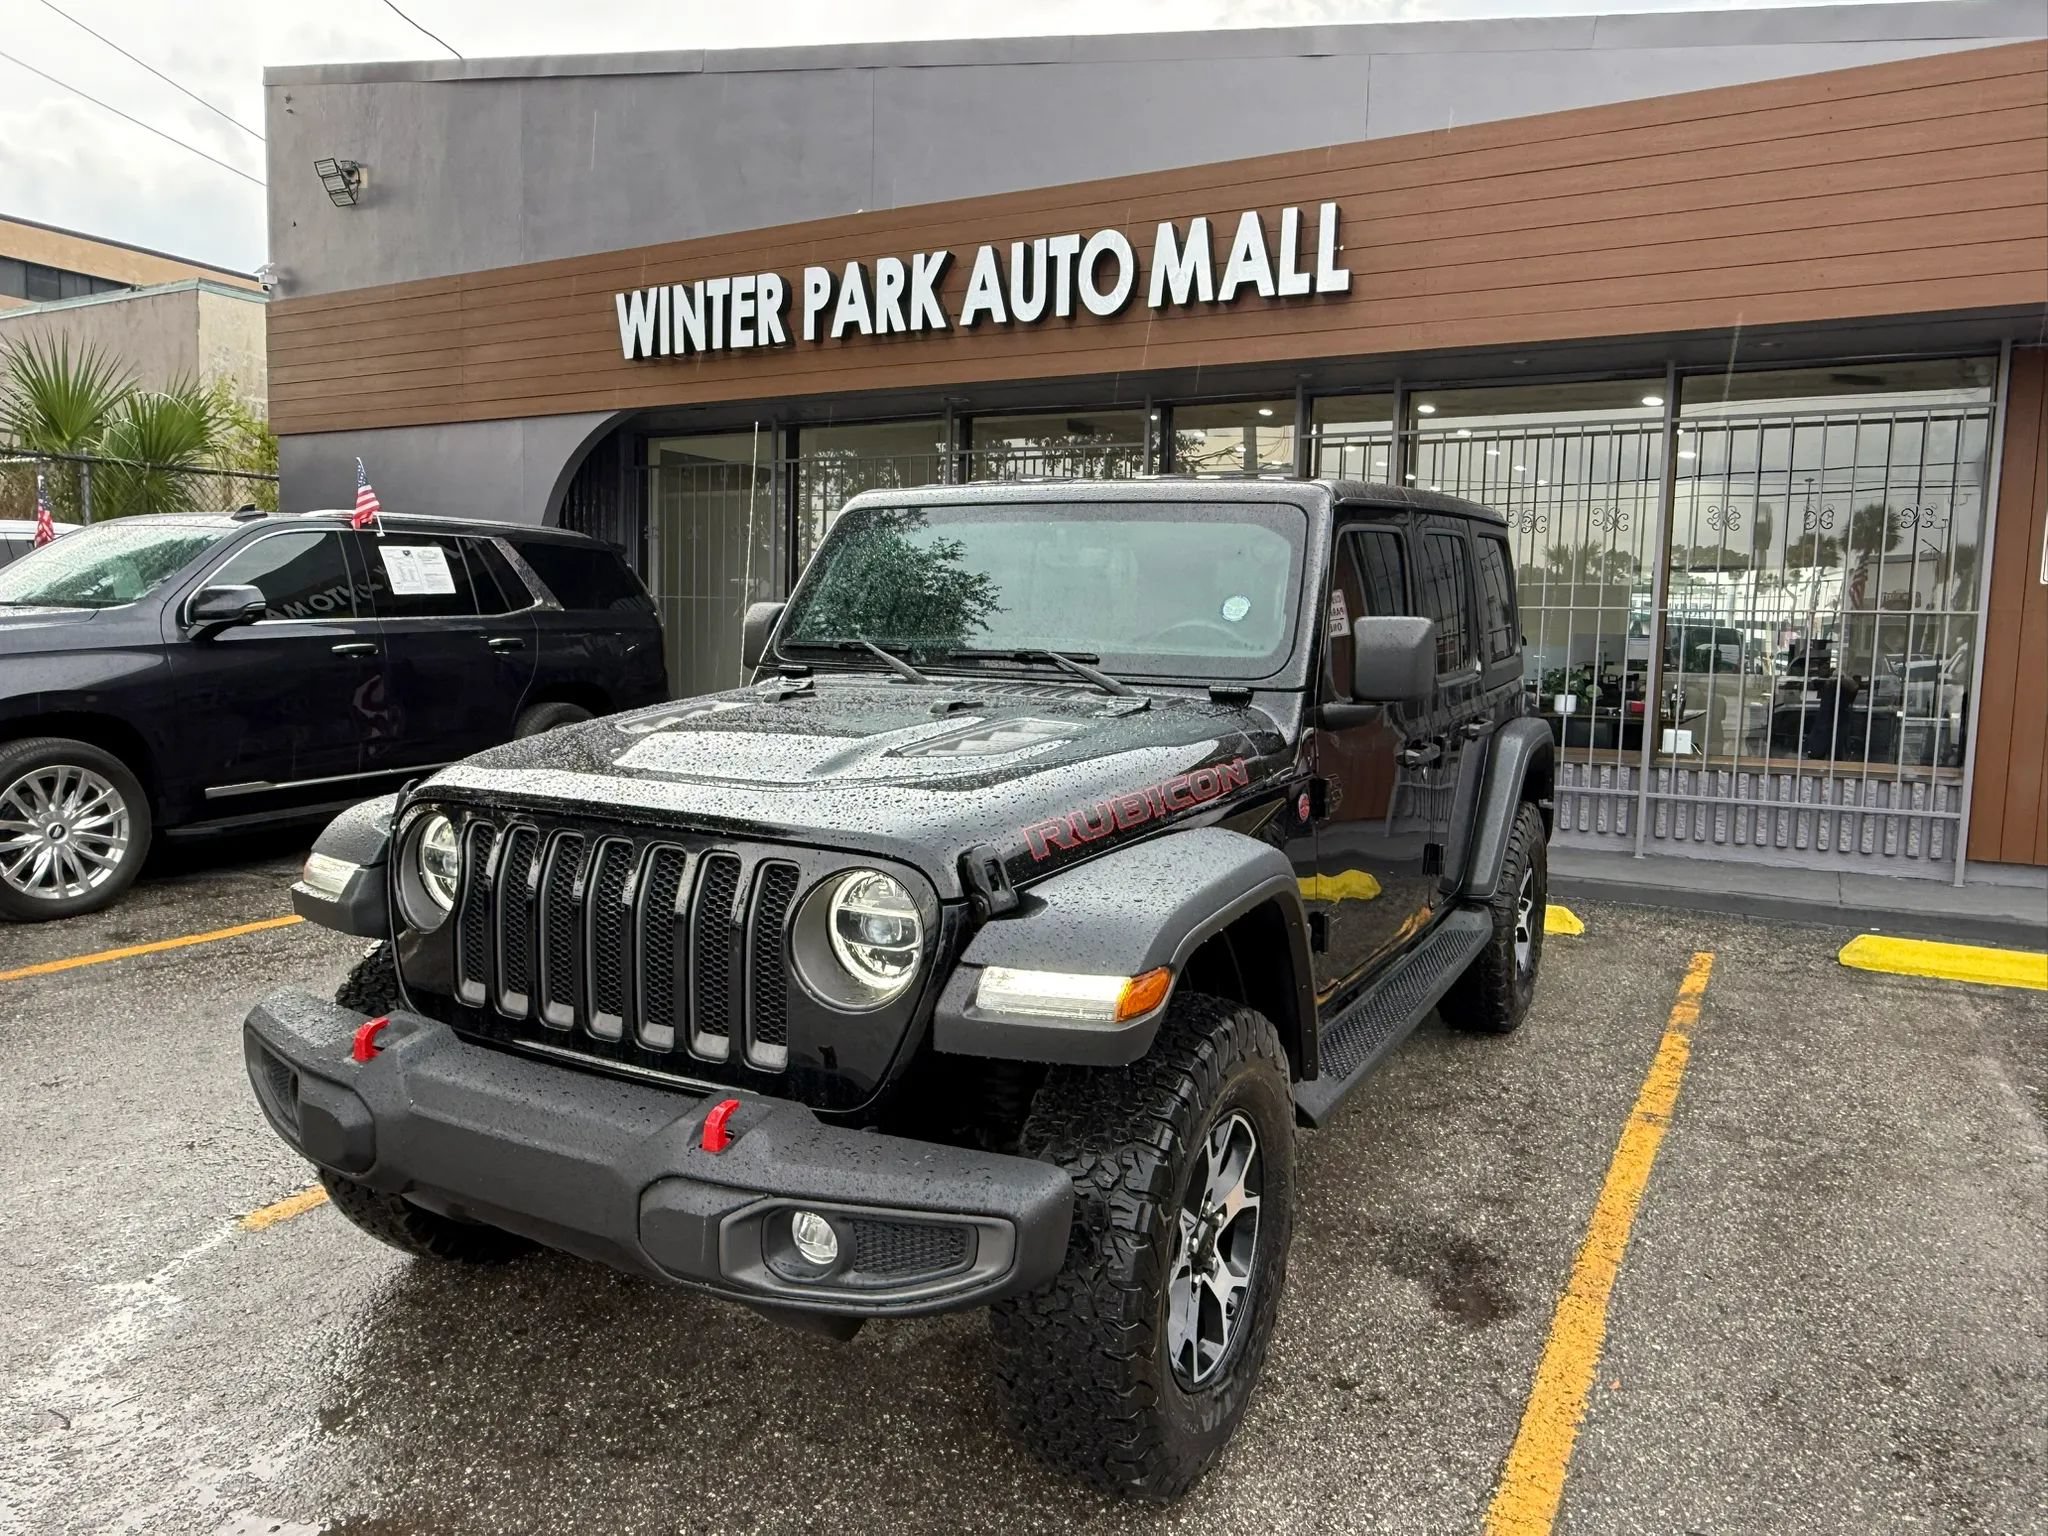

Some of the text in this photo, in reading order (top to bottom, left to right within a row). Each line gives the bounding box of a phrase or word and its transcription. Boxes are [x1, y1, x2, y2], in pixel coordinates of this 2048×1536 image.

[615, 202, 1350, 360] WINTER PARK AUTO MALL
[1022, 757, 1249, 862] RUBICON
